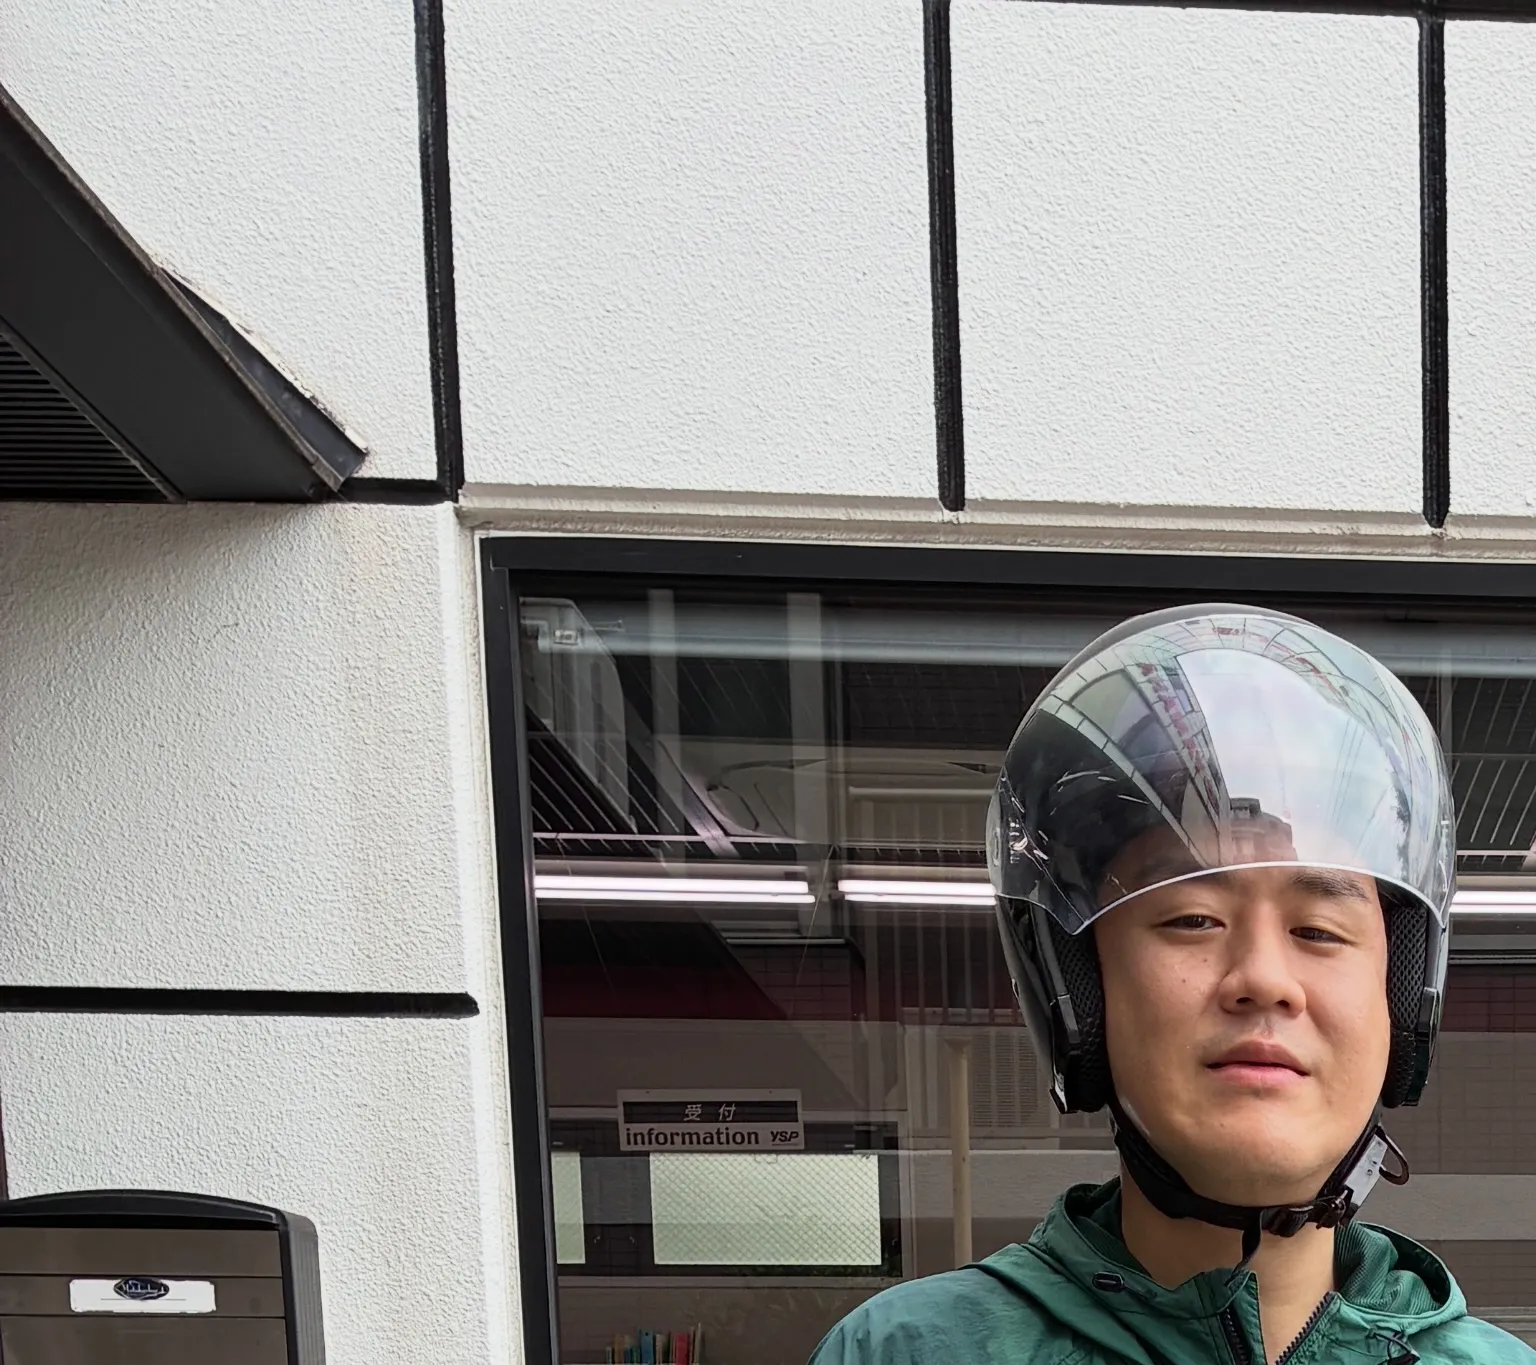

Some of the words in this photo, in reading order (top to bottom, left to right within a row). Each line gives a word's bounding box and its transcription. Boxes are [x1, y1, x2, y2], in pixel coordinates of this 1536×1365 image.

[683, 1103, 737, 1122] 受付
[625, 1126, 760, 1147] information
[769, 1130, 800, 1145] YSP
